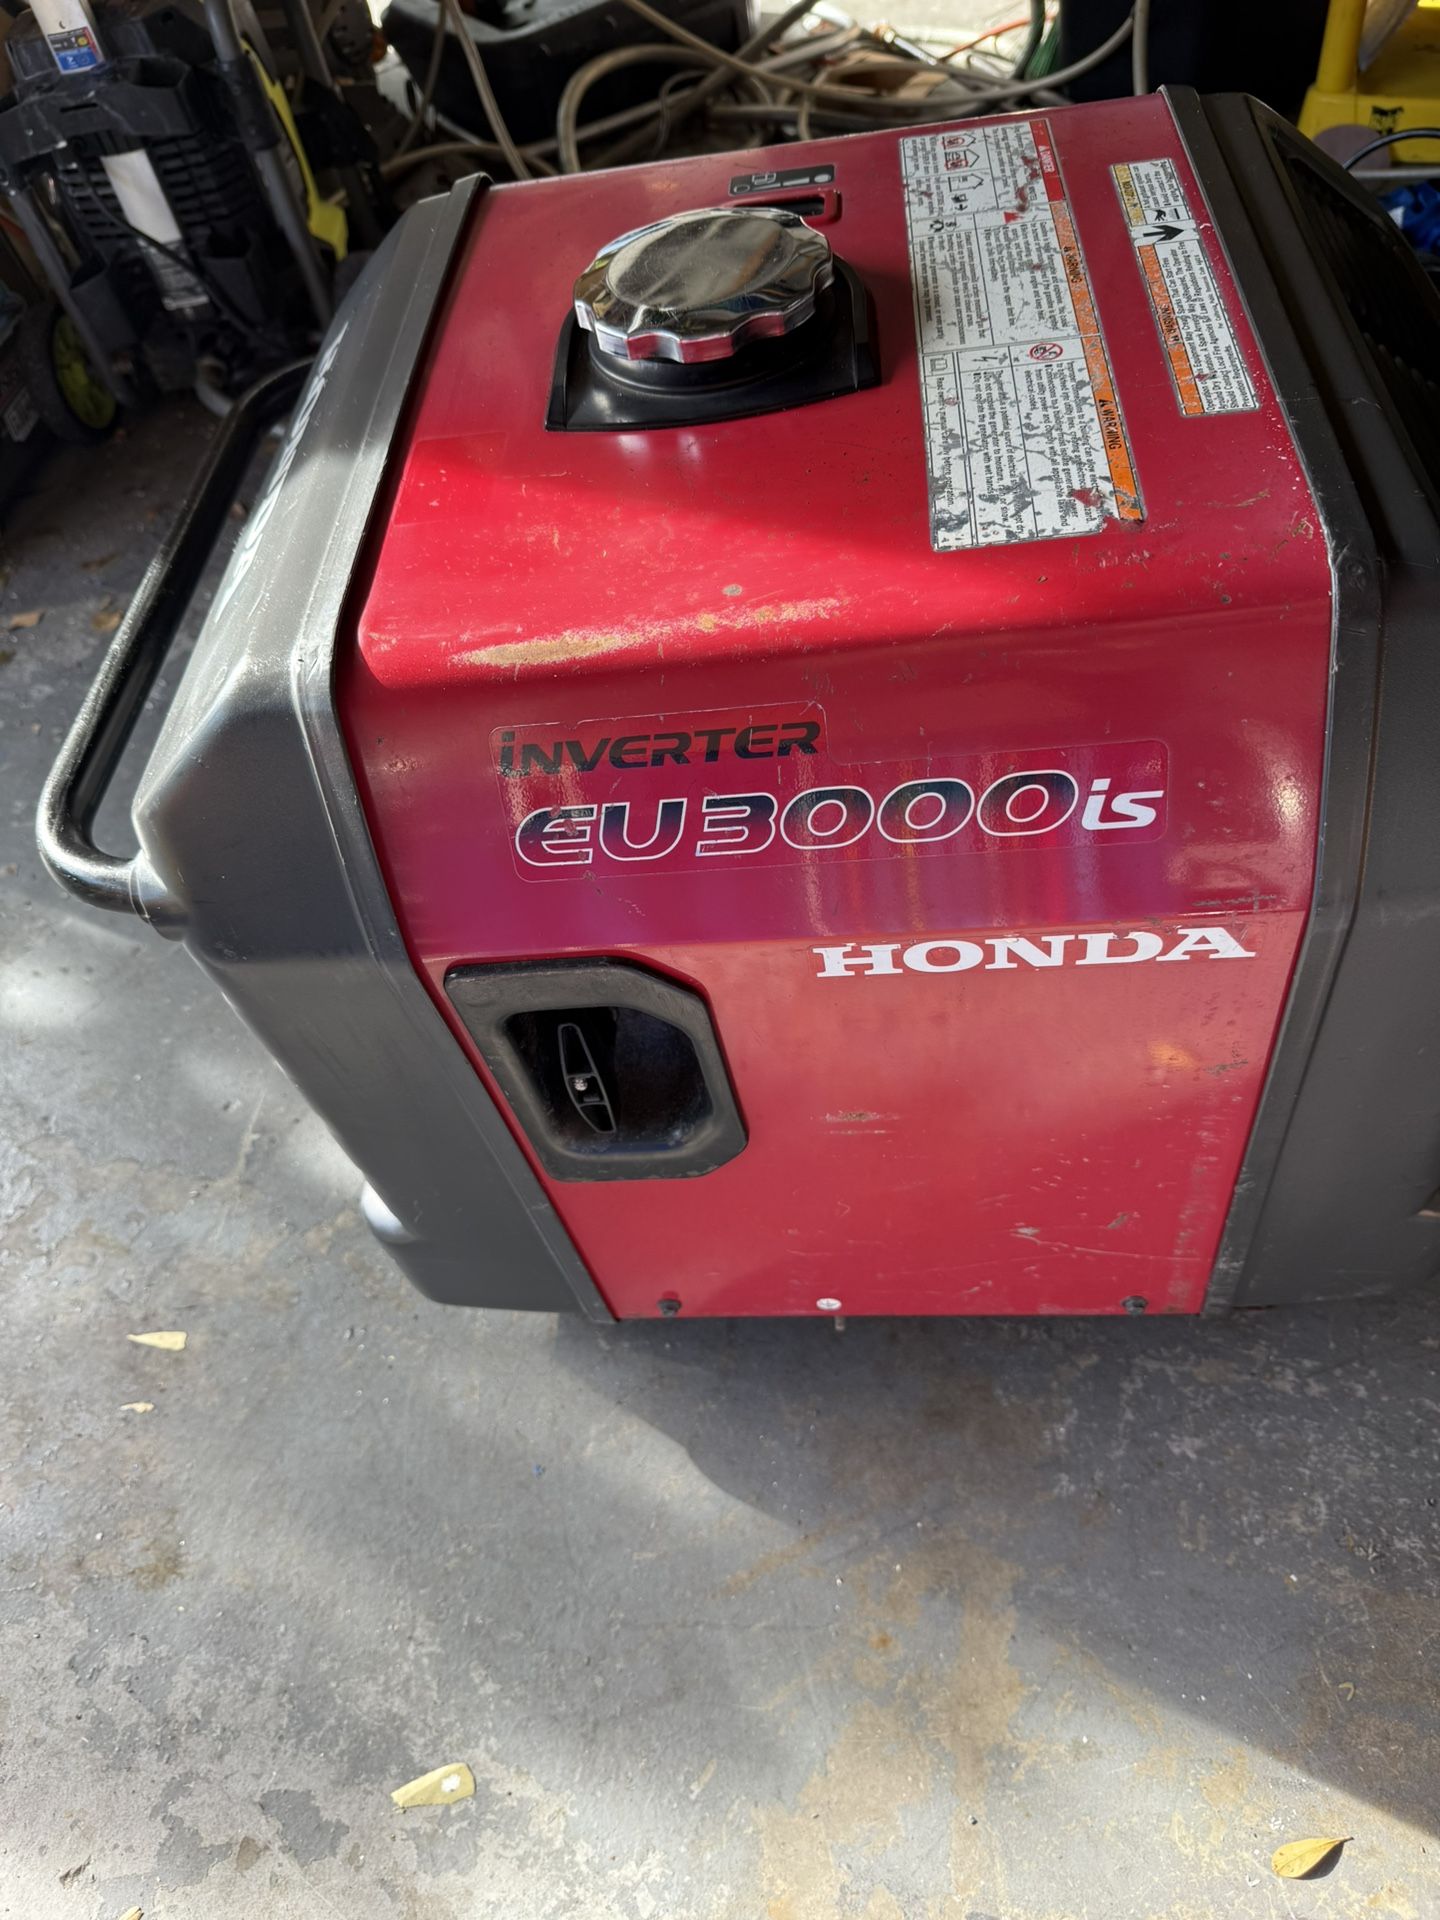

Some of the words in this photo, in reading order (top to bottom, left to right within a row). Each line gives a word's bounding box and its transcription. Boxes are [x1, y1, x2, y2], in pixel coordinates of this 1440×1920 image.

[1173, 266, 1183, 275] The
[1180, 254, 1195, 272] Relating
[1163, 267, 1174, 279] Start
[1166, 278, 1177, 288] Can
[1185, 271, 1203, 297] Regulations
[1169, 287, 1180, 298] That
[1172, 298, 1185, 314] Sparks
[1185, 302, 1197, 313] May
[1196, 302, 1208, 315] Laws
[1182, 330, 1195, 342] May
[1194, 332, 1208, 347] Spark
[1185, 340, 1203, 368] Equipment
[1210, 345, 1221, 356] Fire
[1213, 354, 1226, 370] Local
[936, 376, 945, 390] Read
[1210, 379, 1223, 391] Dry
[1199, 384, 1216, 411] Operation
[1224, 388, 1239, 409] Should
[1233, 379, 1251, 408] Prevention
[1044, 366, 1059, 399] Connections
[1056, 431, 1067, 447] must
[987, 420, 1001, 448] generator
[1100, 408, 1122, 450] WARNING
[982, 451, 992, 464] with
[1083, 445, 1094, 458] can
[943, 455, 954, 476] before
[983, 463, 993, 475] wet
[1006, 453, 1018, 478] electrical
[1085, 457, 1097, 472] allow
[944, 475, 957, 508] operation.
[514, 768, 1166, 868] EU3000is
[811, 927, 1257, 978] HONDA
